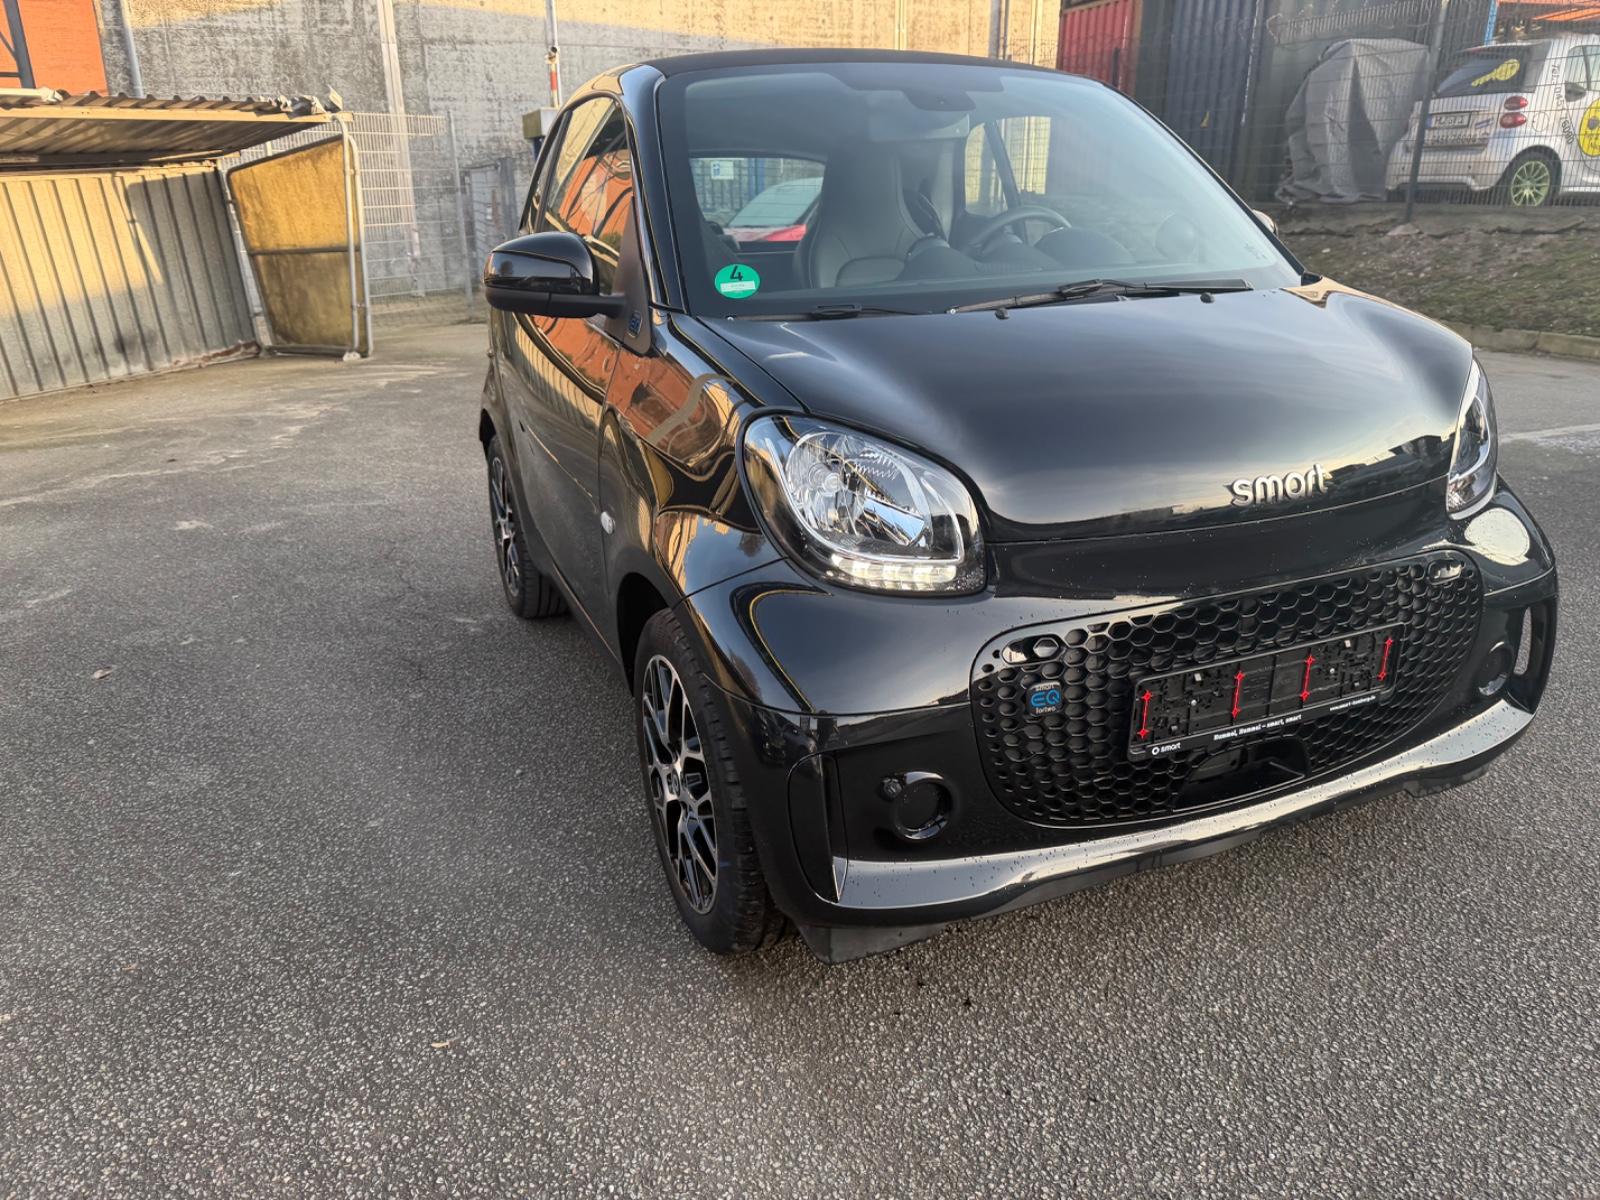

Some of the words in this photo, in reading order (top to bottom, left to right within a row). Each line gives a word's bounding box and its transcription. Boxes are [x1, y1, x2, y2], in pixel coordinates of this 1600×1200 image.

[730, 265, 744, 281] 4
[1231, 463, 1328, 507] smart
[1031, 689, 1060, 707] EQ
